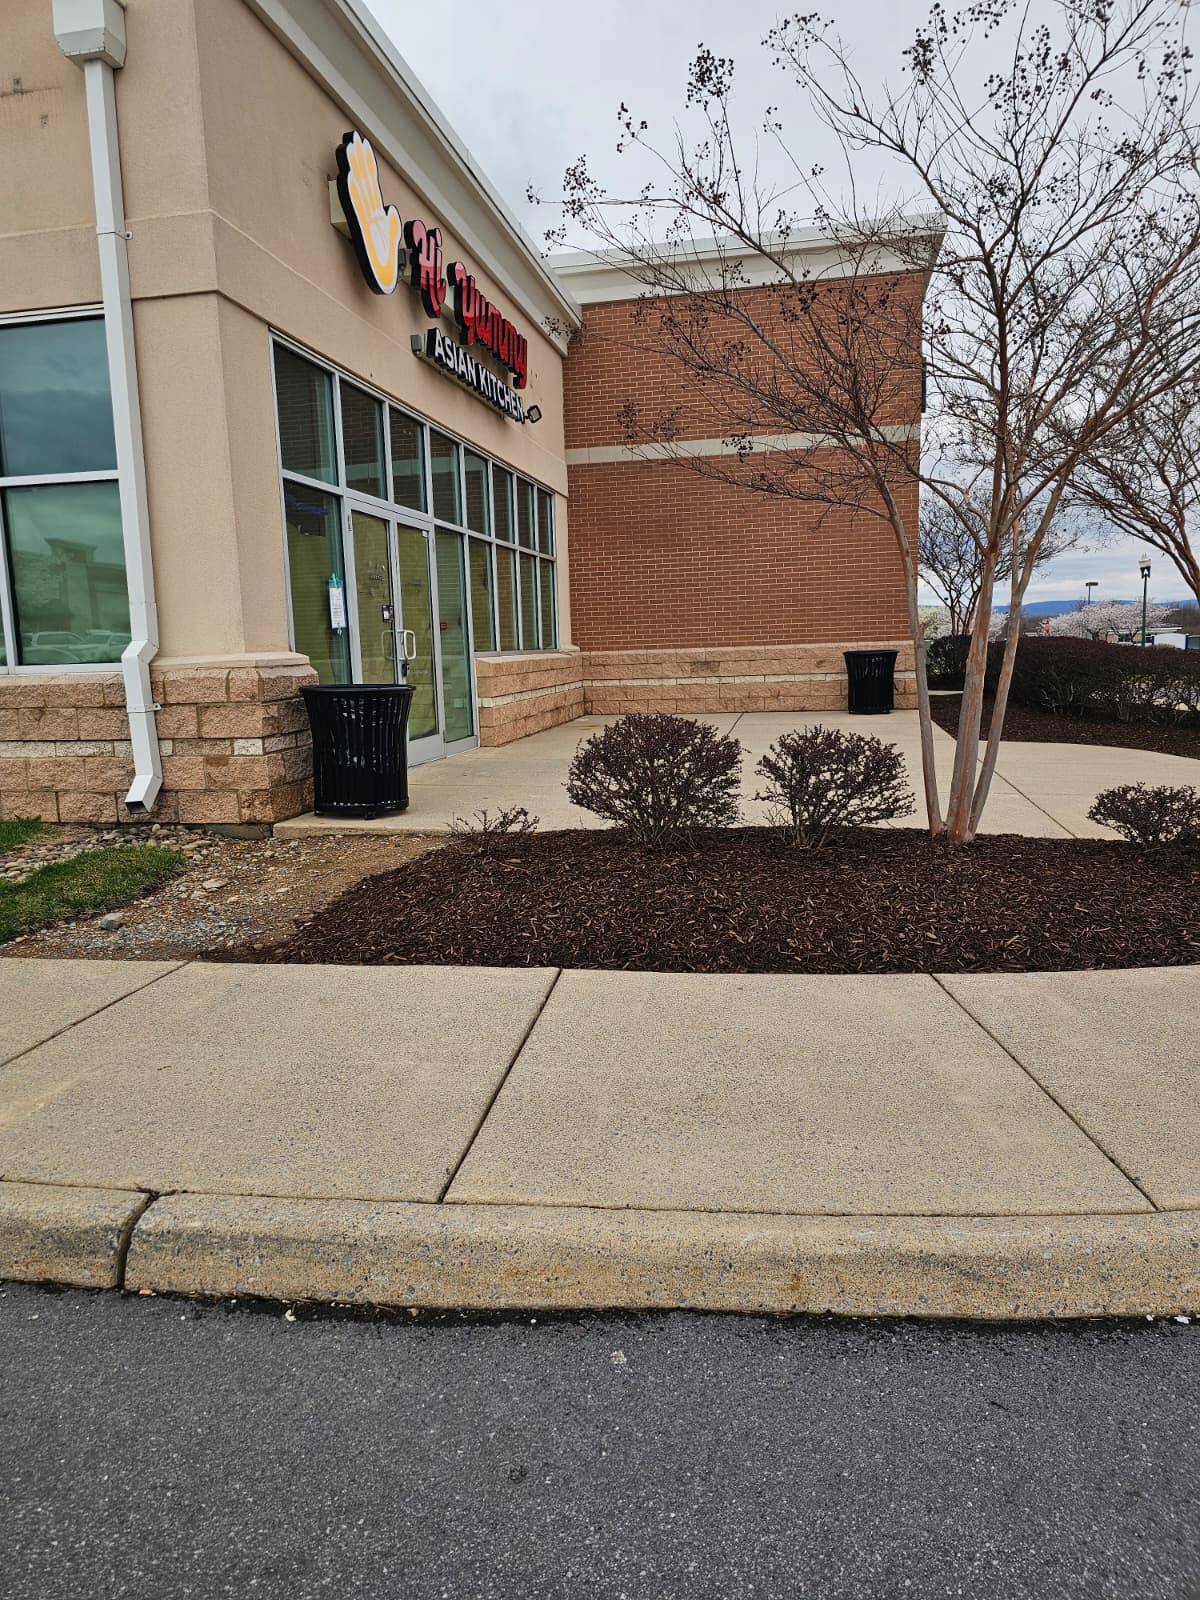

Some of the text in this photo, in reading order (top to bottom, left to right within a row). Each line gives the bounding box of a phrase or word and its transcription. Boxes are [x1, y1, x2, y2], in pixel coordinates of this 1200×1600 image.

[407, 219, 446, 319] Hi
[430, 328, 527, 424] ASIAN KITCHEN
